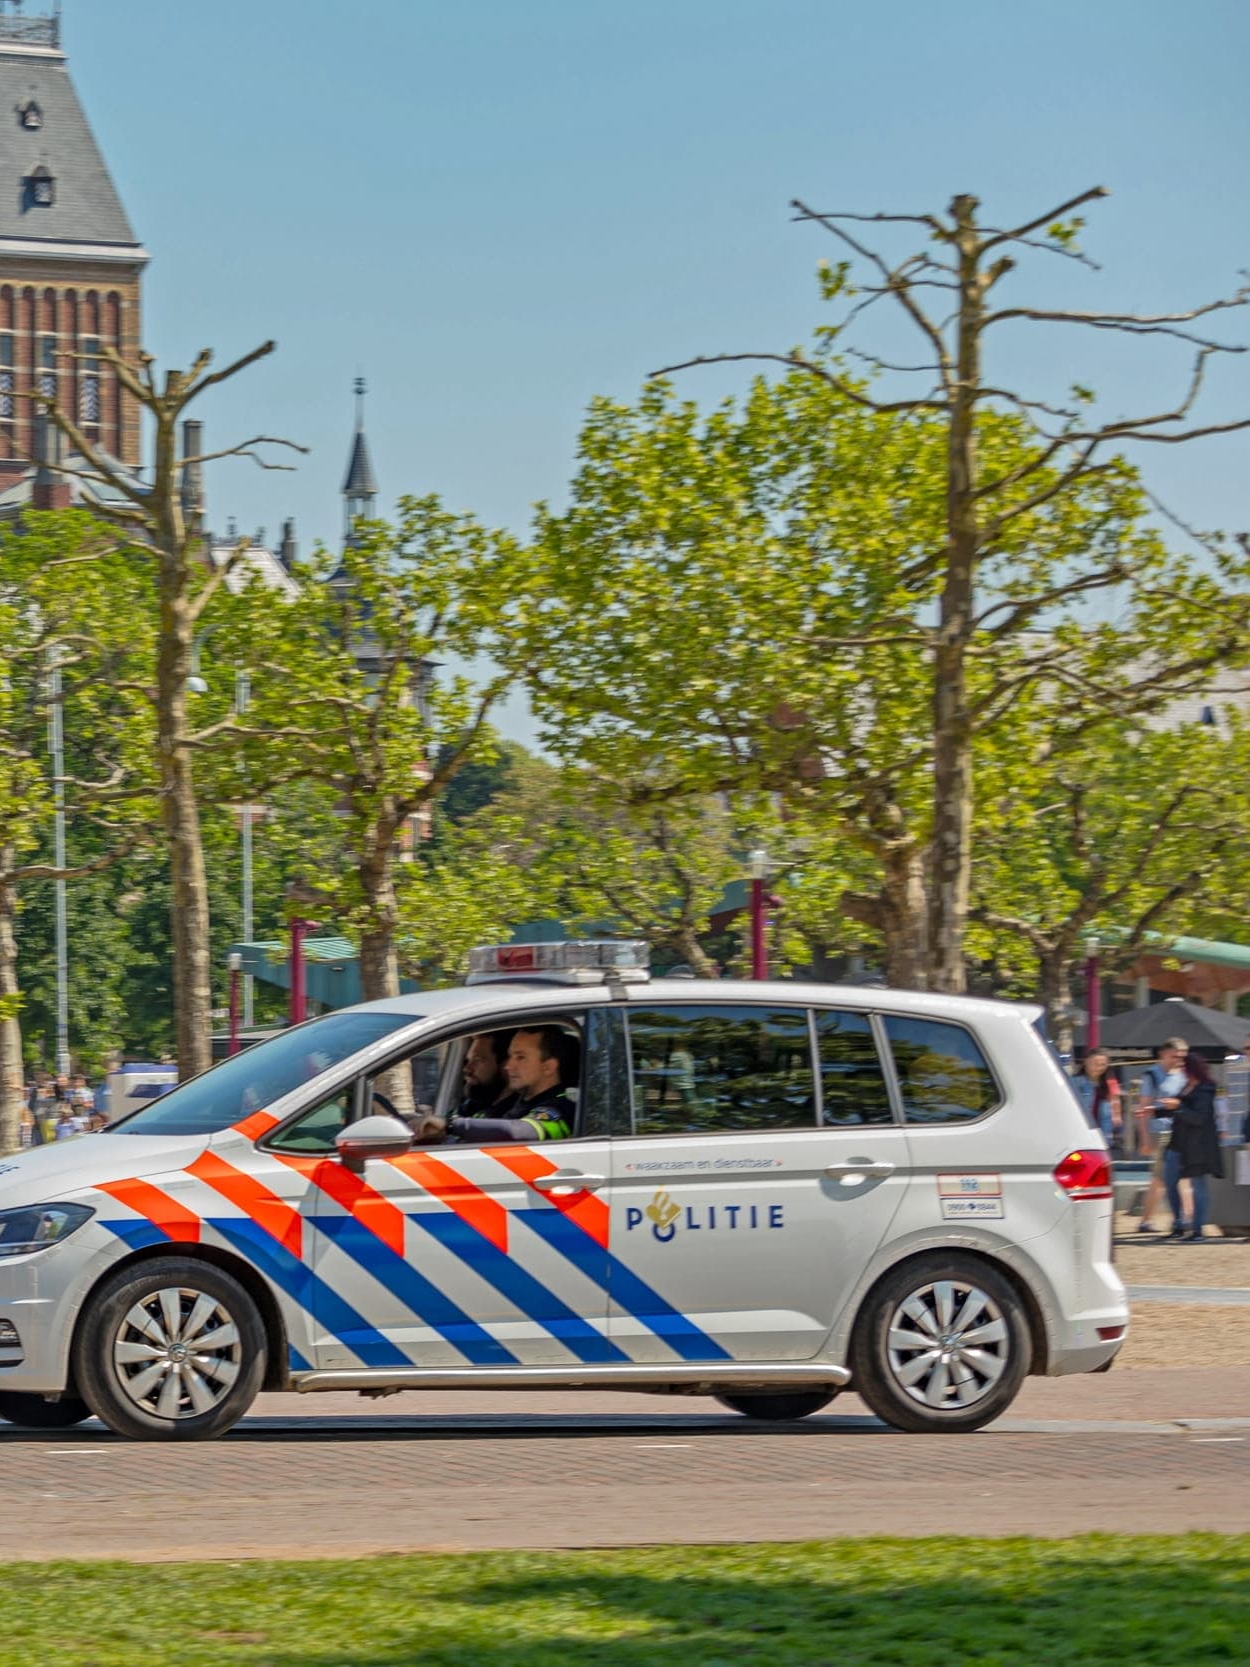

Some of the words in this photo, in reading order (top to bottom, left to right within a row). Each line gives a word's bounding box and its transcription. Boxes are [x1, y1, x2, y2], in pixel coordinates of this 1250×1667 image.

[637, 1161, 693, 1171] waakzaam
[696, 1160, 710, 1170] en
[714, 1158, 775, 1169] dienstbaar
[626, 1204, 784, 1243] POLITIE
